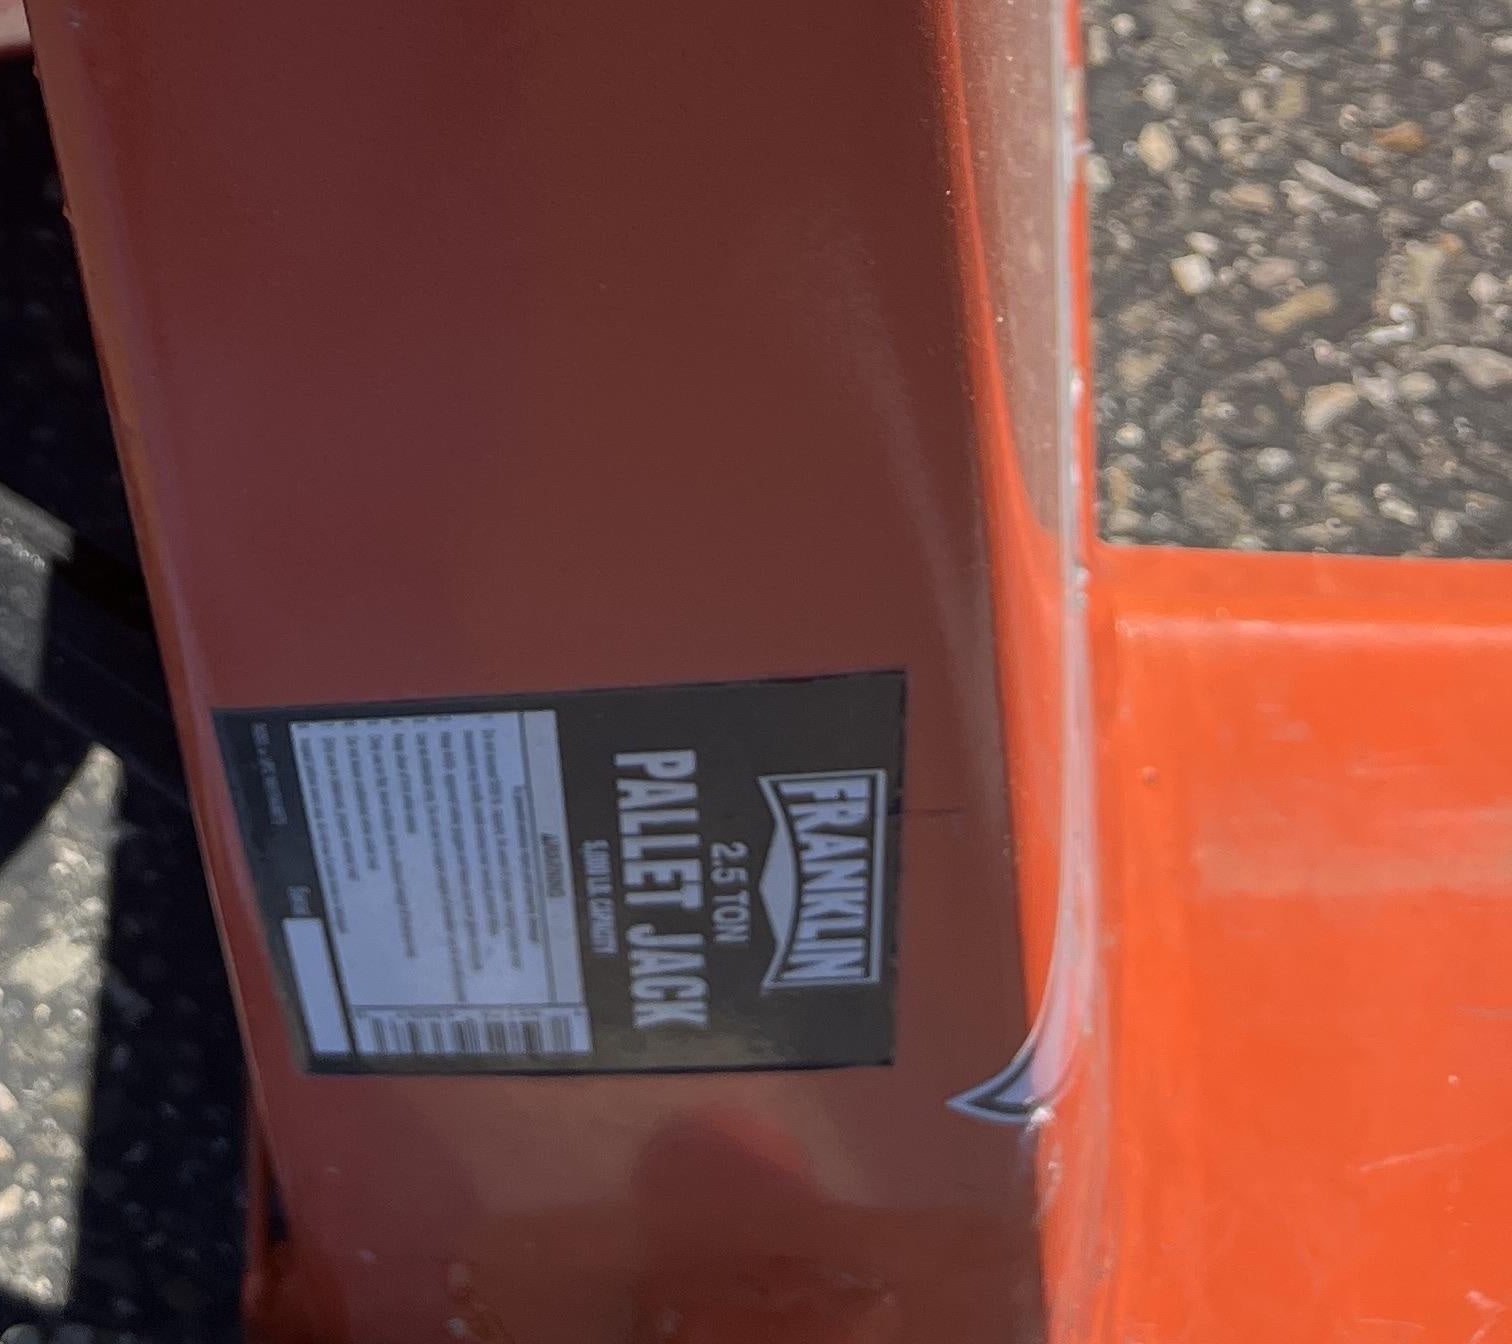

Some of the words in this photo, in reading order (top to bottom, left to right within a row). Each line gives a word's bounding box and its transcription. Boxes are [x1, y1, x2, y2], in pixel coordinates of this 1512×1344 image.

[614, 749, 704, 910] PALLET
[710, 841, 750, 885] 2.5
[777, 777, 871, 983] FRANKLIN
[712, 889, 751, 944] TON
[625, 922, 710, 1030] JACK
